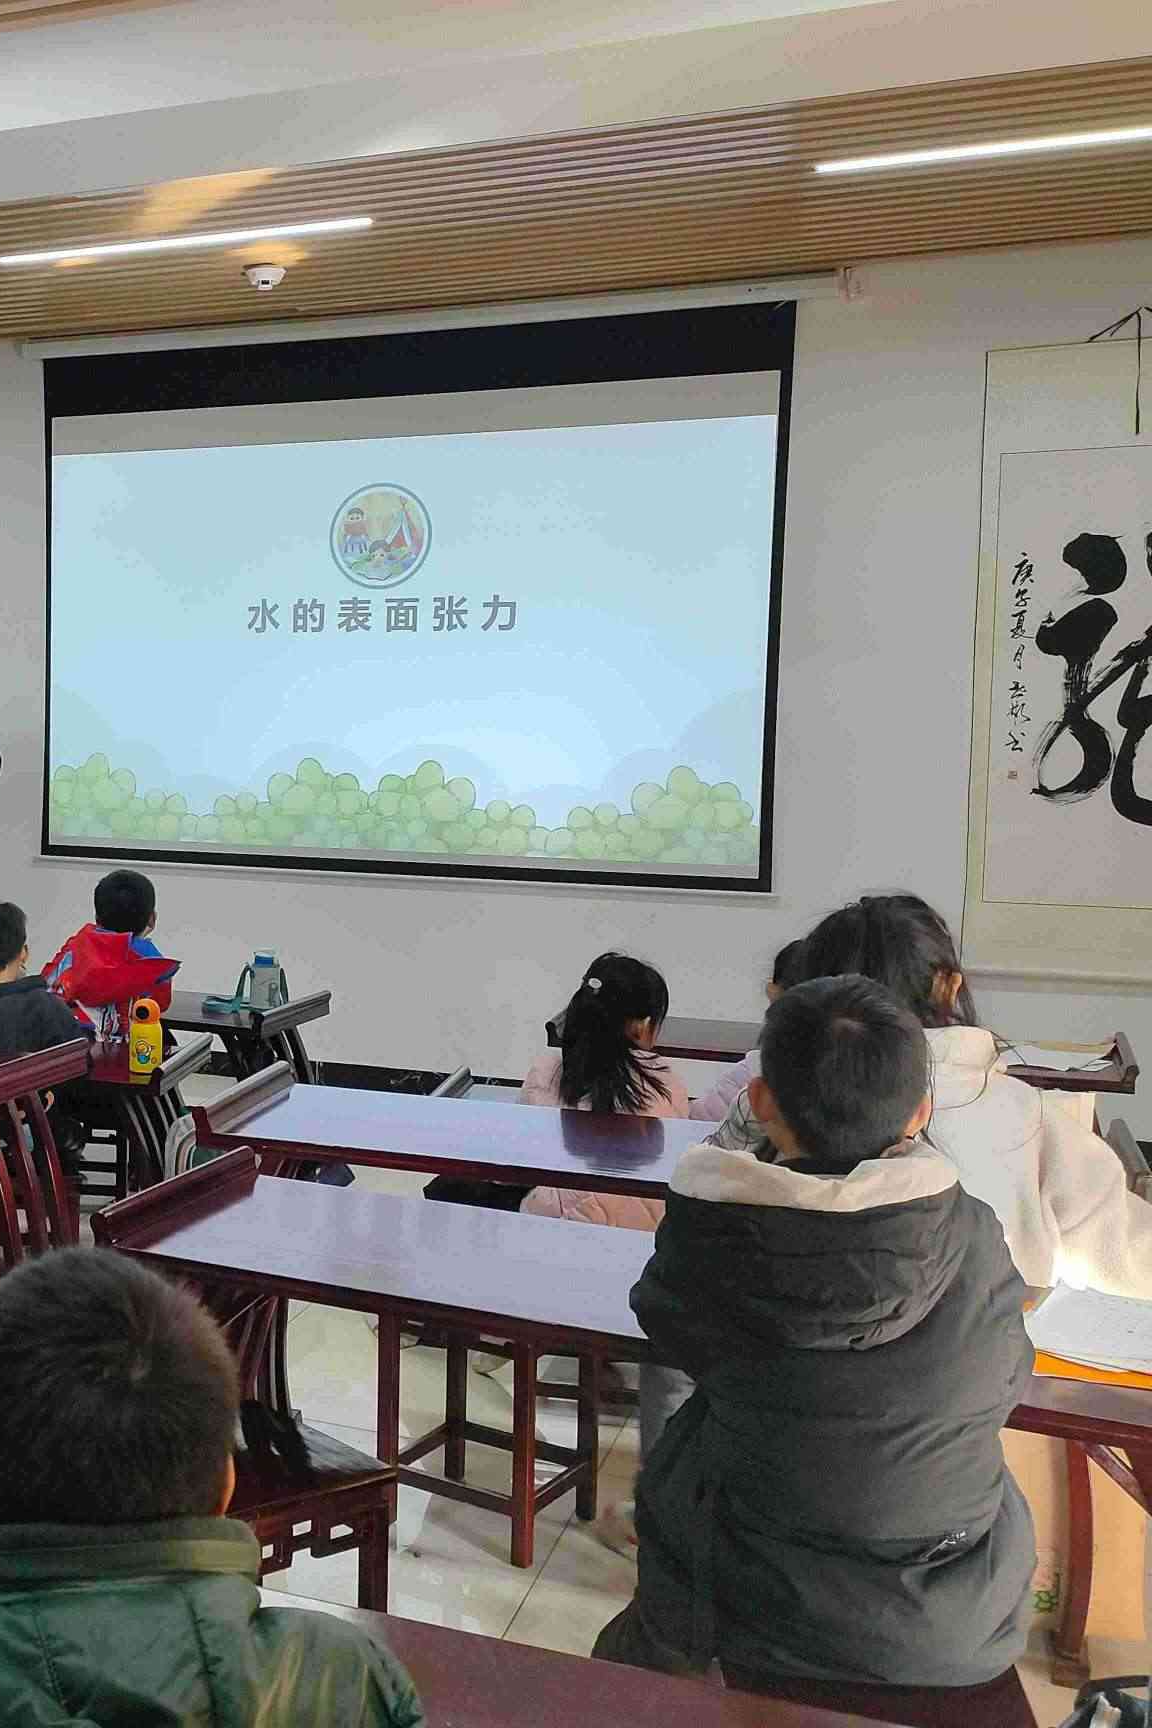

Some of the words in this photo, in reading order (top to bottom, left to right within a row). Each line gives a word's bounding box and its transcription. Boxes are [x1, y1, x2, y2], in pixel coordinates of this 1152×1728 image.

[247, 594, 517, 633] 水的表面张力
